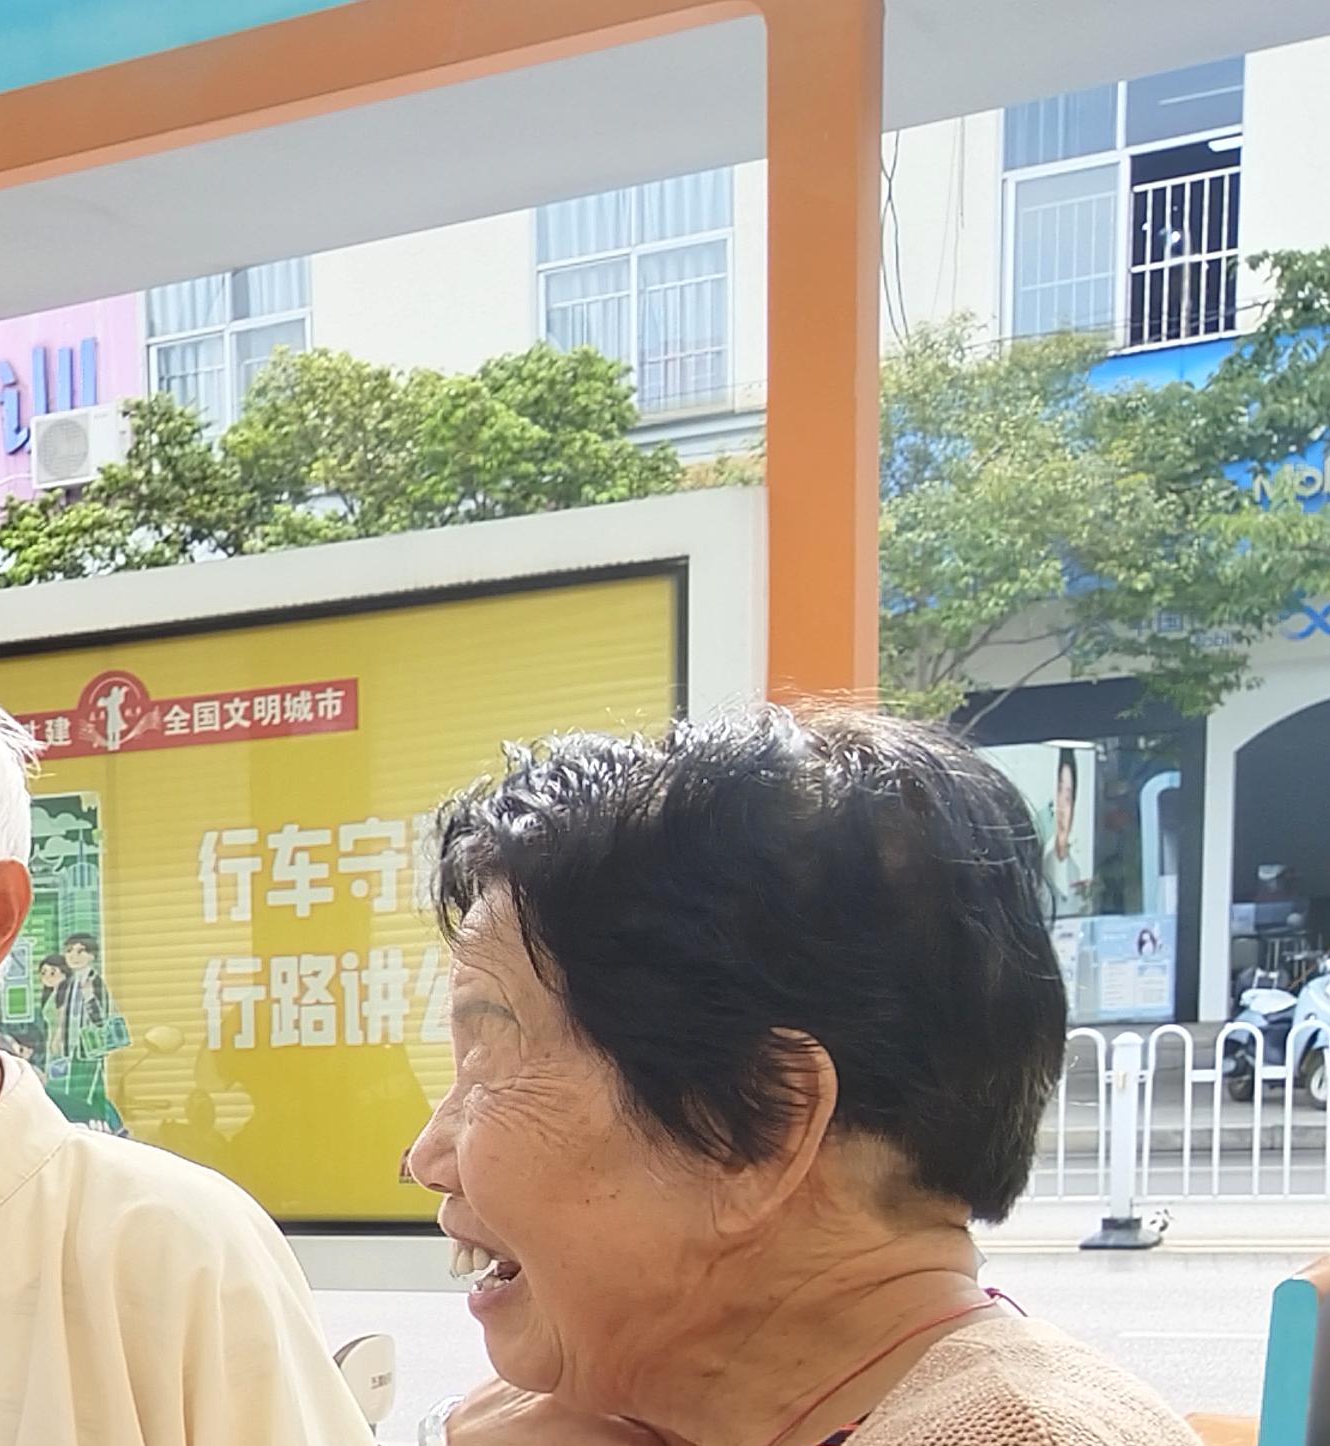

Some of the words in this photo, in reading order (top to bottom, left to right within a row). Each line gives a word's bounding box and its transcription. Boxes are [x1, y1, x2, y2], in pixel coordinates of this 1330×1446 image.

[164, 687, 345, 736] 全国文明城市
